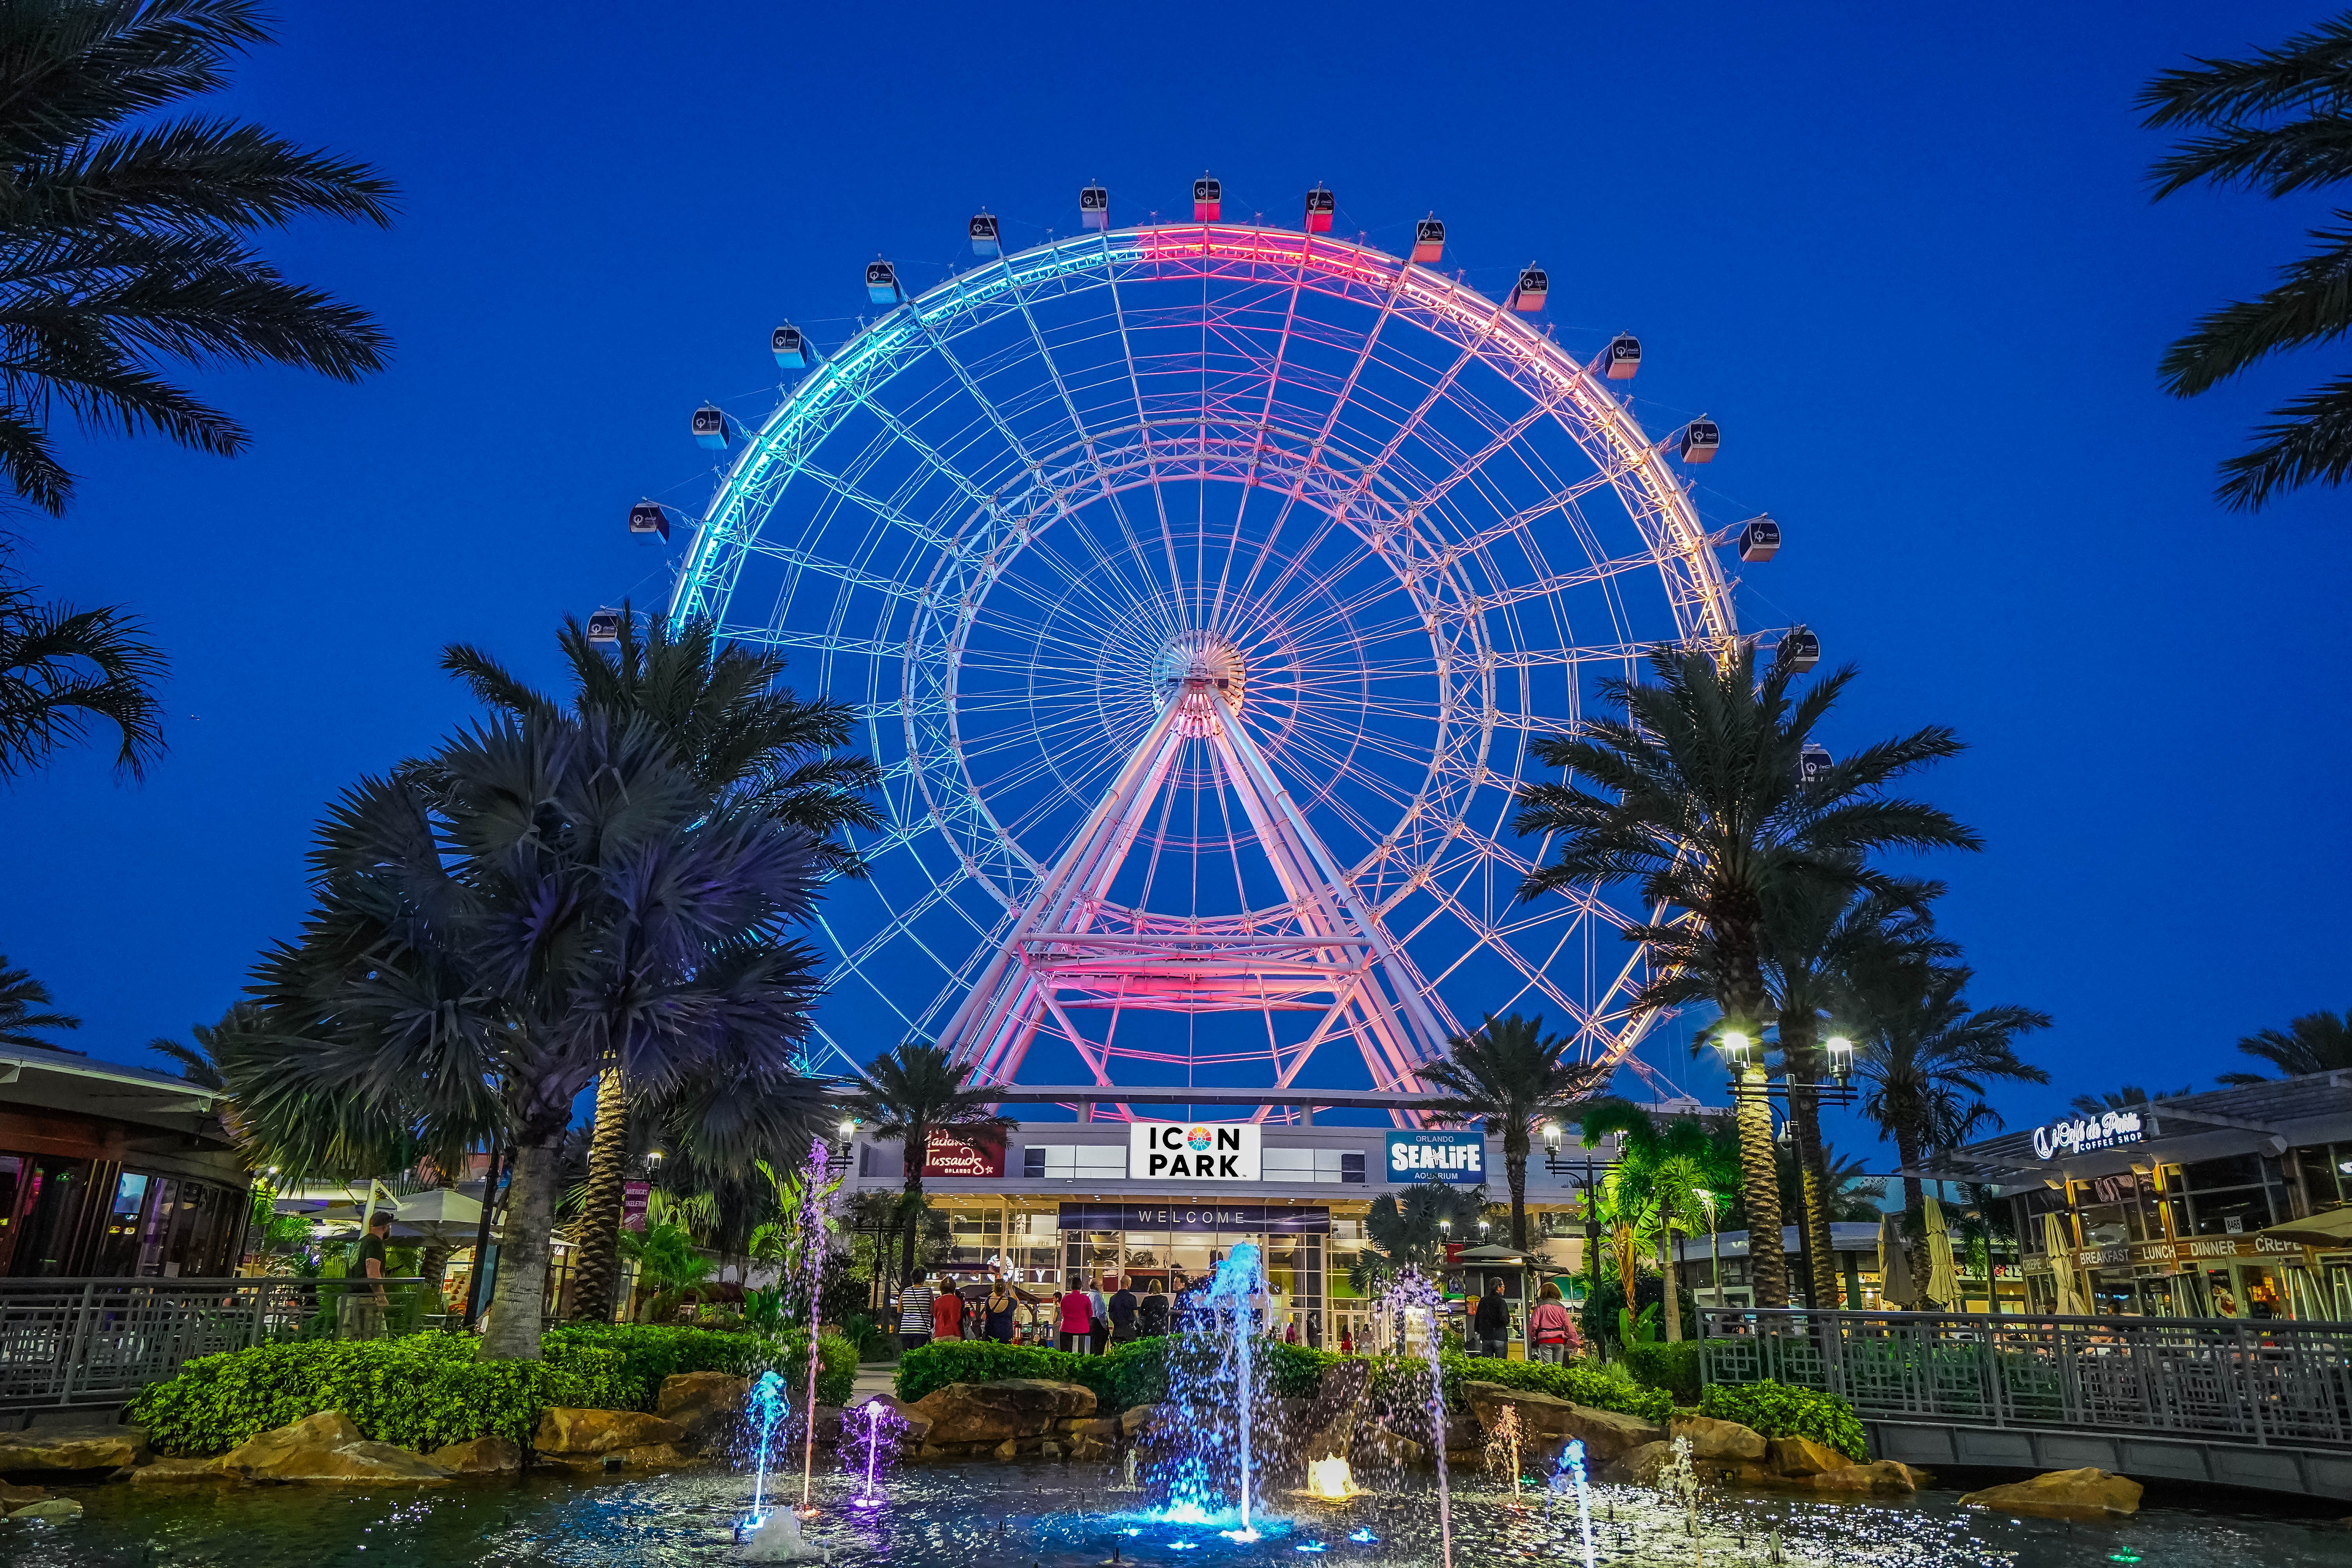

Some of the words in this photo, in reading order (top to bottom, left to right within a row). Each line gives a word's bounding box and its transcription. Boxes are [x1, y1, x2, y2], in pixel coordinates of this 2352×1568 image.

[1150, 1127, 1240, 1151] ICON
[2080, 1138, 2114, 1151] COFFEE
[2118, 1132, 2141, 1144] SHOP
[1150, 1154, 1239, 1177] PARK
[1139, 1210, 1244, 1223] WELCOME
[2227, 1219, 2241, 1230] 8465
[2080, 1249, 2129, 1265] BREAKFAST
[2142, 1245, 2176, 1259] LUNCH
[2190, 1241, 2237, 1256] DINNER
